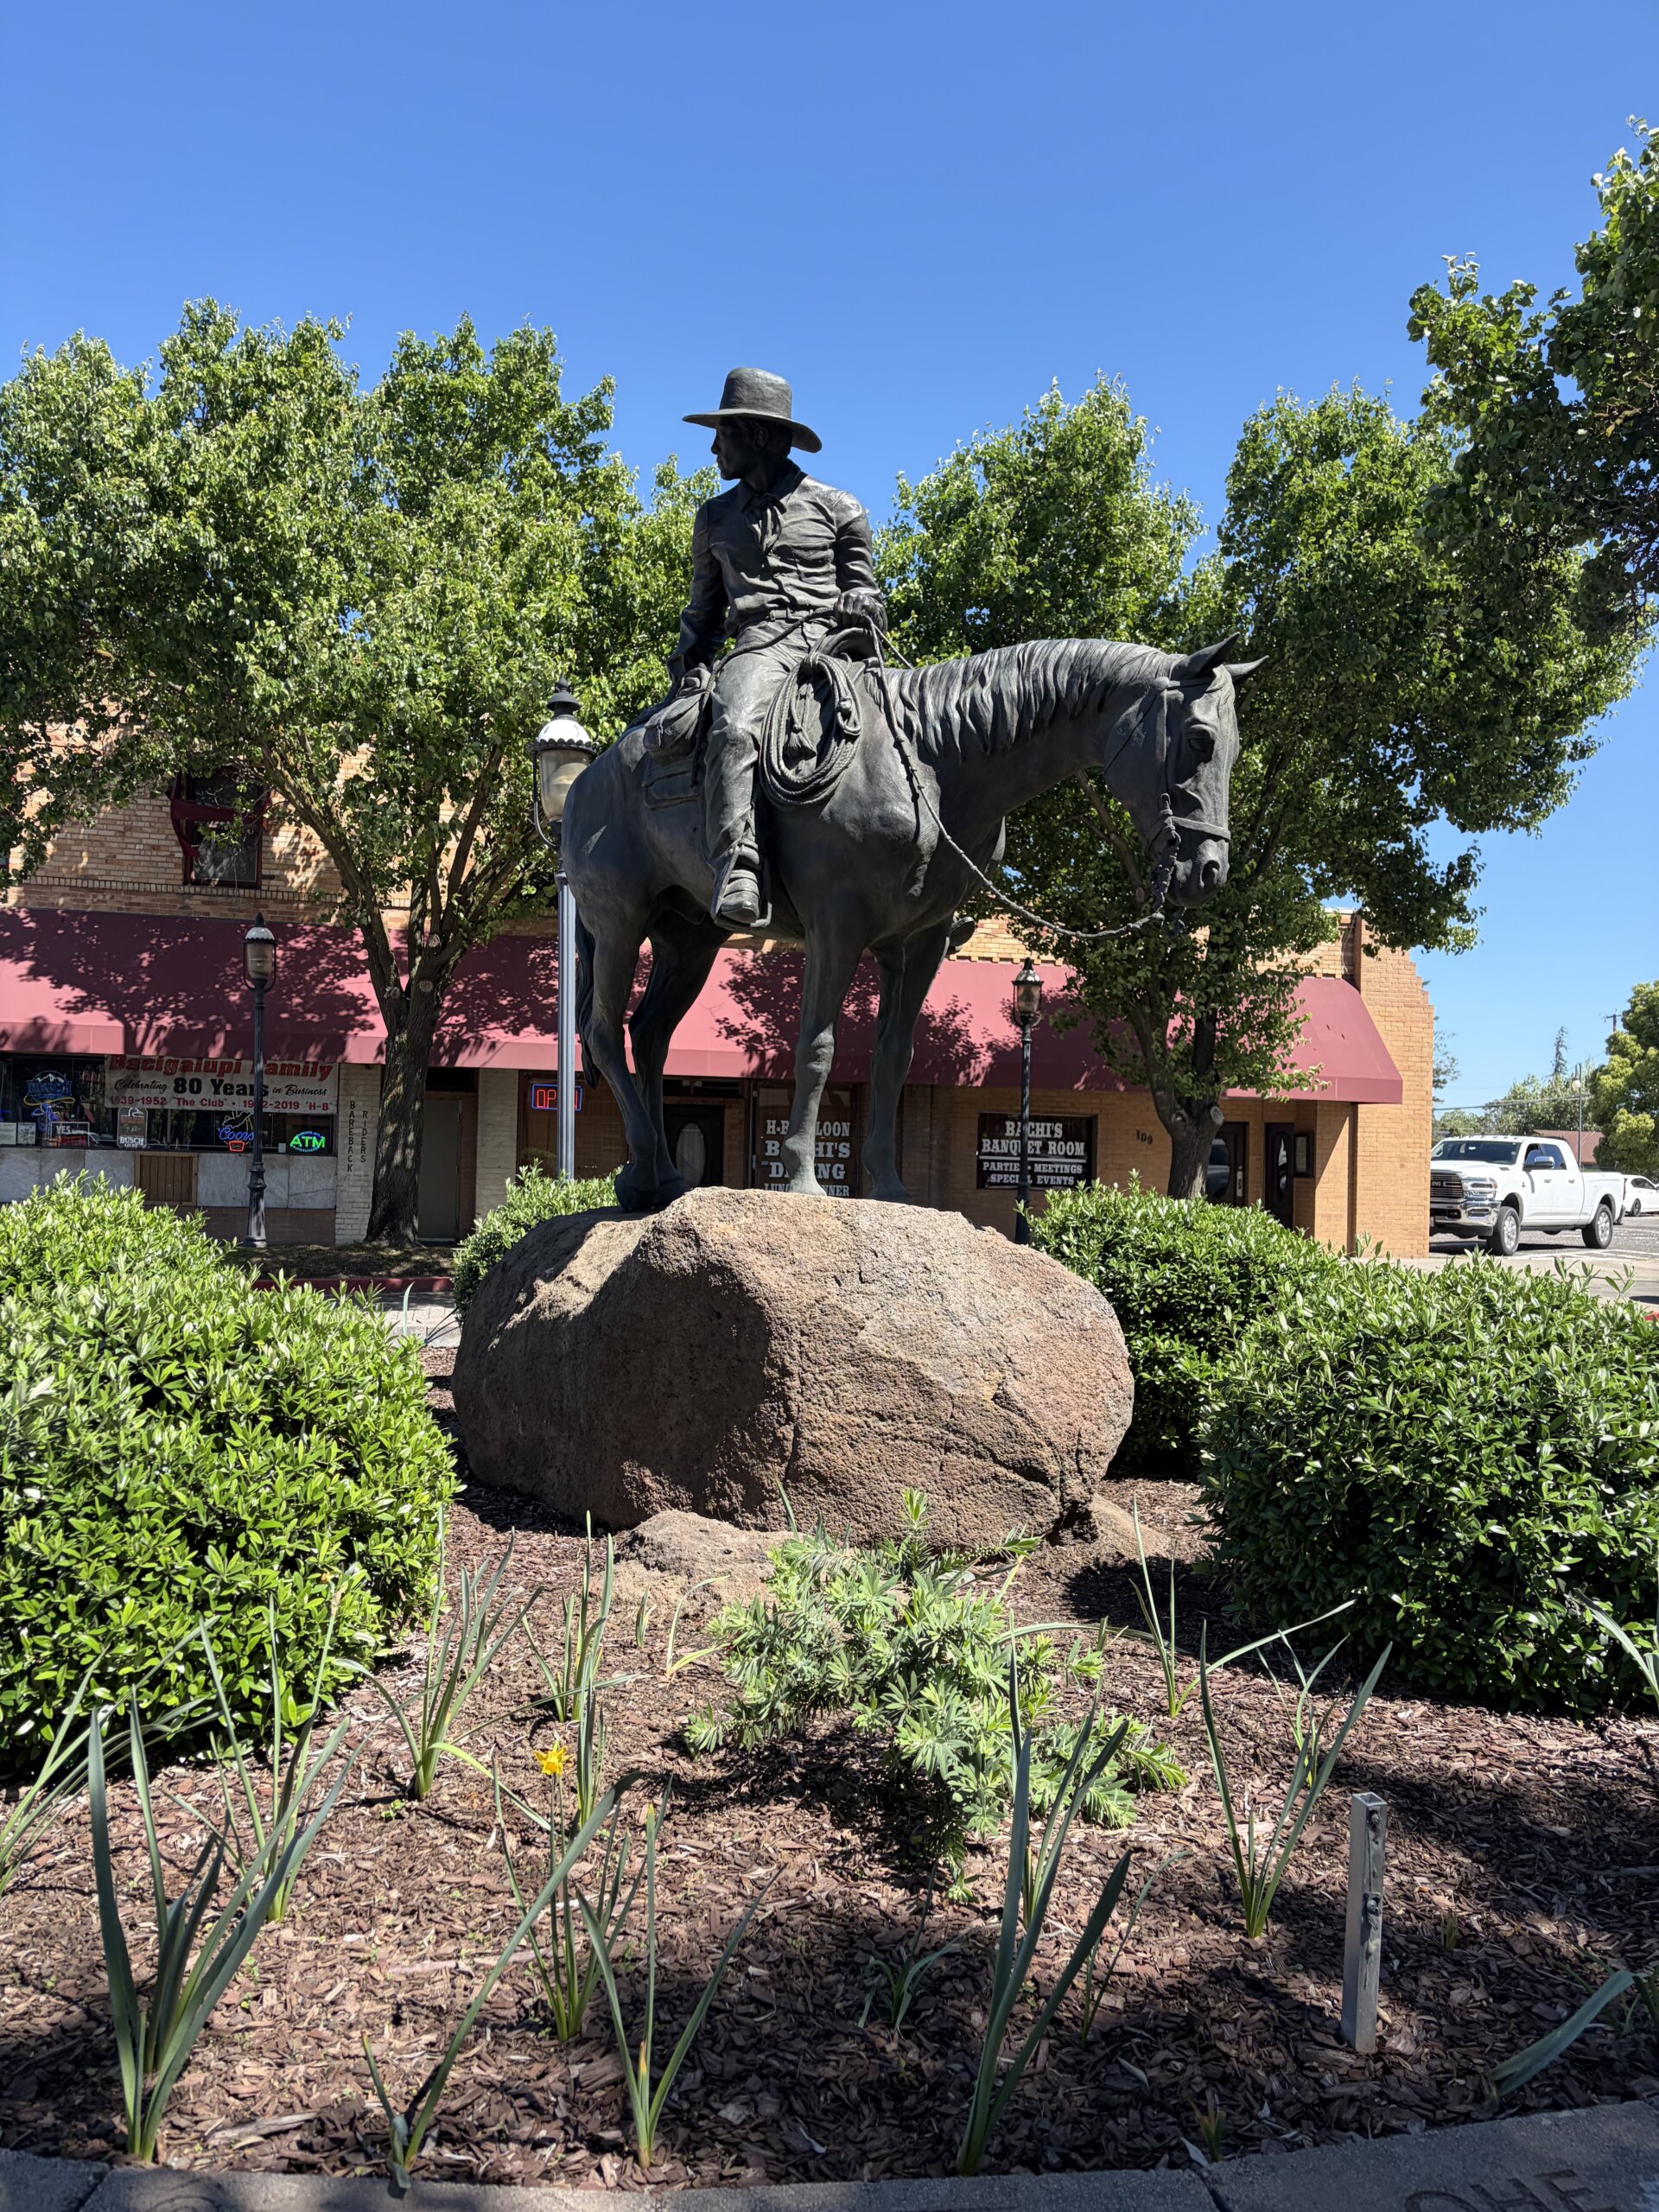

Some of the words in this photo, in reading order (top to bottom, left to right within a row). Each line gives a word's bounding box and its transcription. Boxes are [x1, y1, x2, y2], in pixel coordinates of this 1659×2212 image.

[110, 1054, 242, 1077] Bacigalupi
[115, 1078, 167, 1094] Celebrating
[174, 1077, 202, 1095] 80
[285, 1084, 327, 1096] Business
[243, 1099, 300, 1110] 192-2019
[218, 1127, 254, 1141] Coors
[814, 1122, 851, 1136] LOON
[119, 1136, 144, 1146] BUSCH
[289, 1135, 326, 1148] ATM
[1136, 1130, 1154, 1145] 109
[765, 1141, 850, 1158] BHI'S
[982, 1139, 1042, 1156] BANQET
[1048, 1141, 1085, 1156] ROOM
[982, 1161, 1020, 1172] PARTIE
[1034, 1164, 1083, 1174] MEETINGS
[990, 1173, 1033, 1185] SPECIL
[1037, 1175, 1075, 1185] EVENTS
